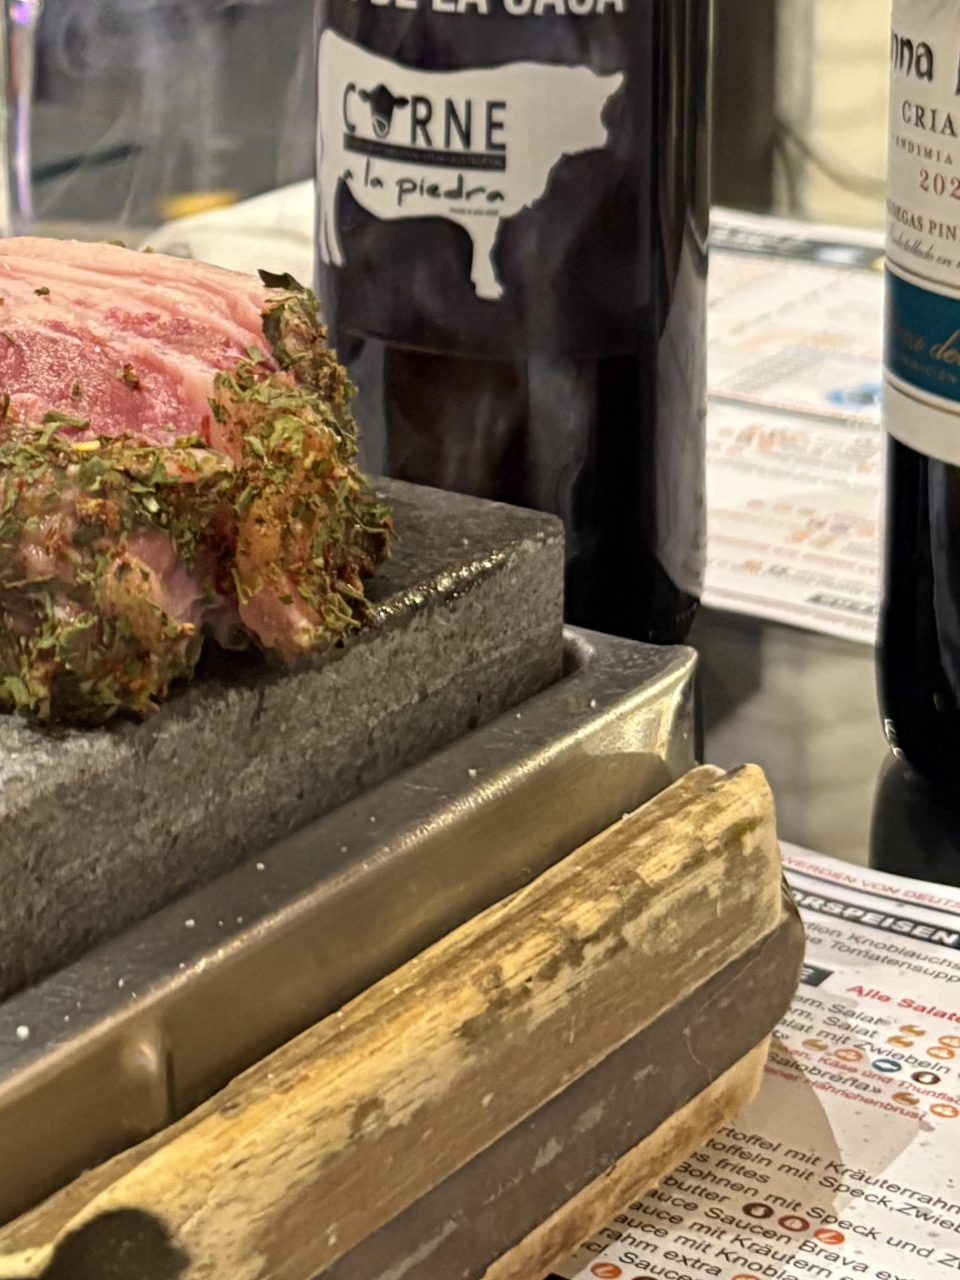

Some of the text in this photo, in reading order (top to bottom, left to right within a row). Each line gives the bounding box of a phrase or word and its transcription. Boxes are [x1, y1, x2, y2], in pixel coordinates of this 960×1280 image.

[364, 157, 384, 188] la
[395, 173, 505, 208] piedra
[862, 880, 901, 895] VON
[846, 985, 891, 1002] Alle
[822, 1016, 879, 1039] Salat
[816, 1030, 851, 1045] mit
[852, 1041, 952, 1075] Zwiebeln
[784, 1148, 821, 1167] mit
[715, 1158, 771, 1184] frites
[777, 1163, 816, 1182] mit
[764, 1193, 802, 1213] mit
[806, 1206, 881, 1240] Speck
[886, 1236, 935, 1258] und
[673, 1234, 712, 1254] mit
[688, 1221, 727, 1240] mit
[730, 1233, 833, 1279] Kräutern
[704, 1207, 793, 1245] Saucen
[797, 1239, 869, 1273] Brava
[663, 1250, 723, 1277] extra
